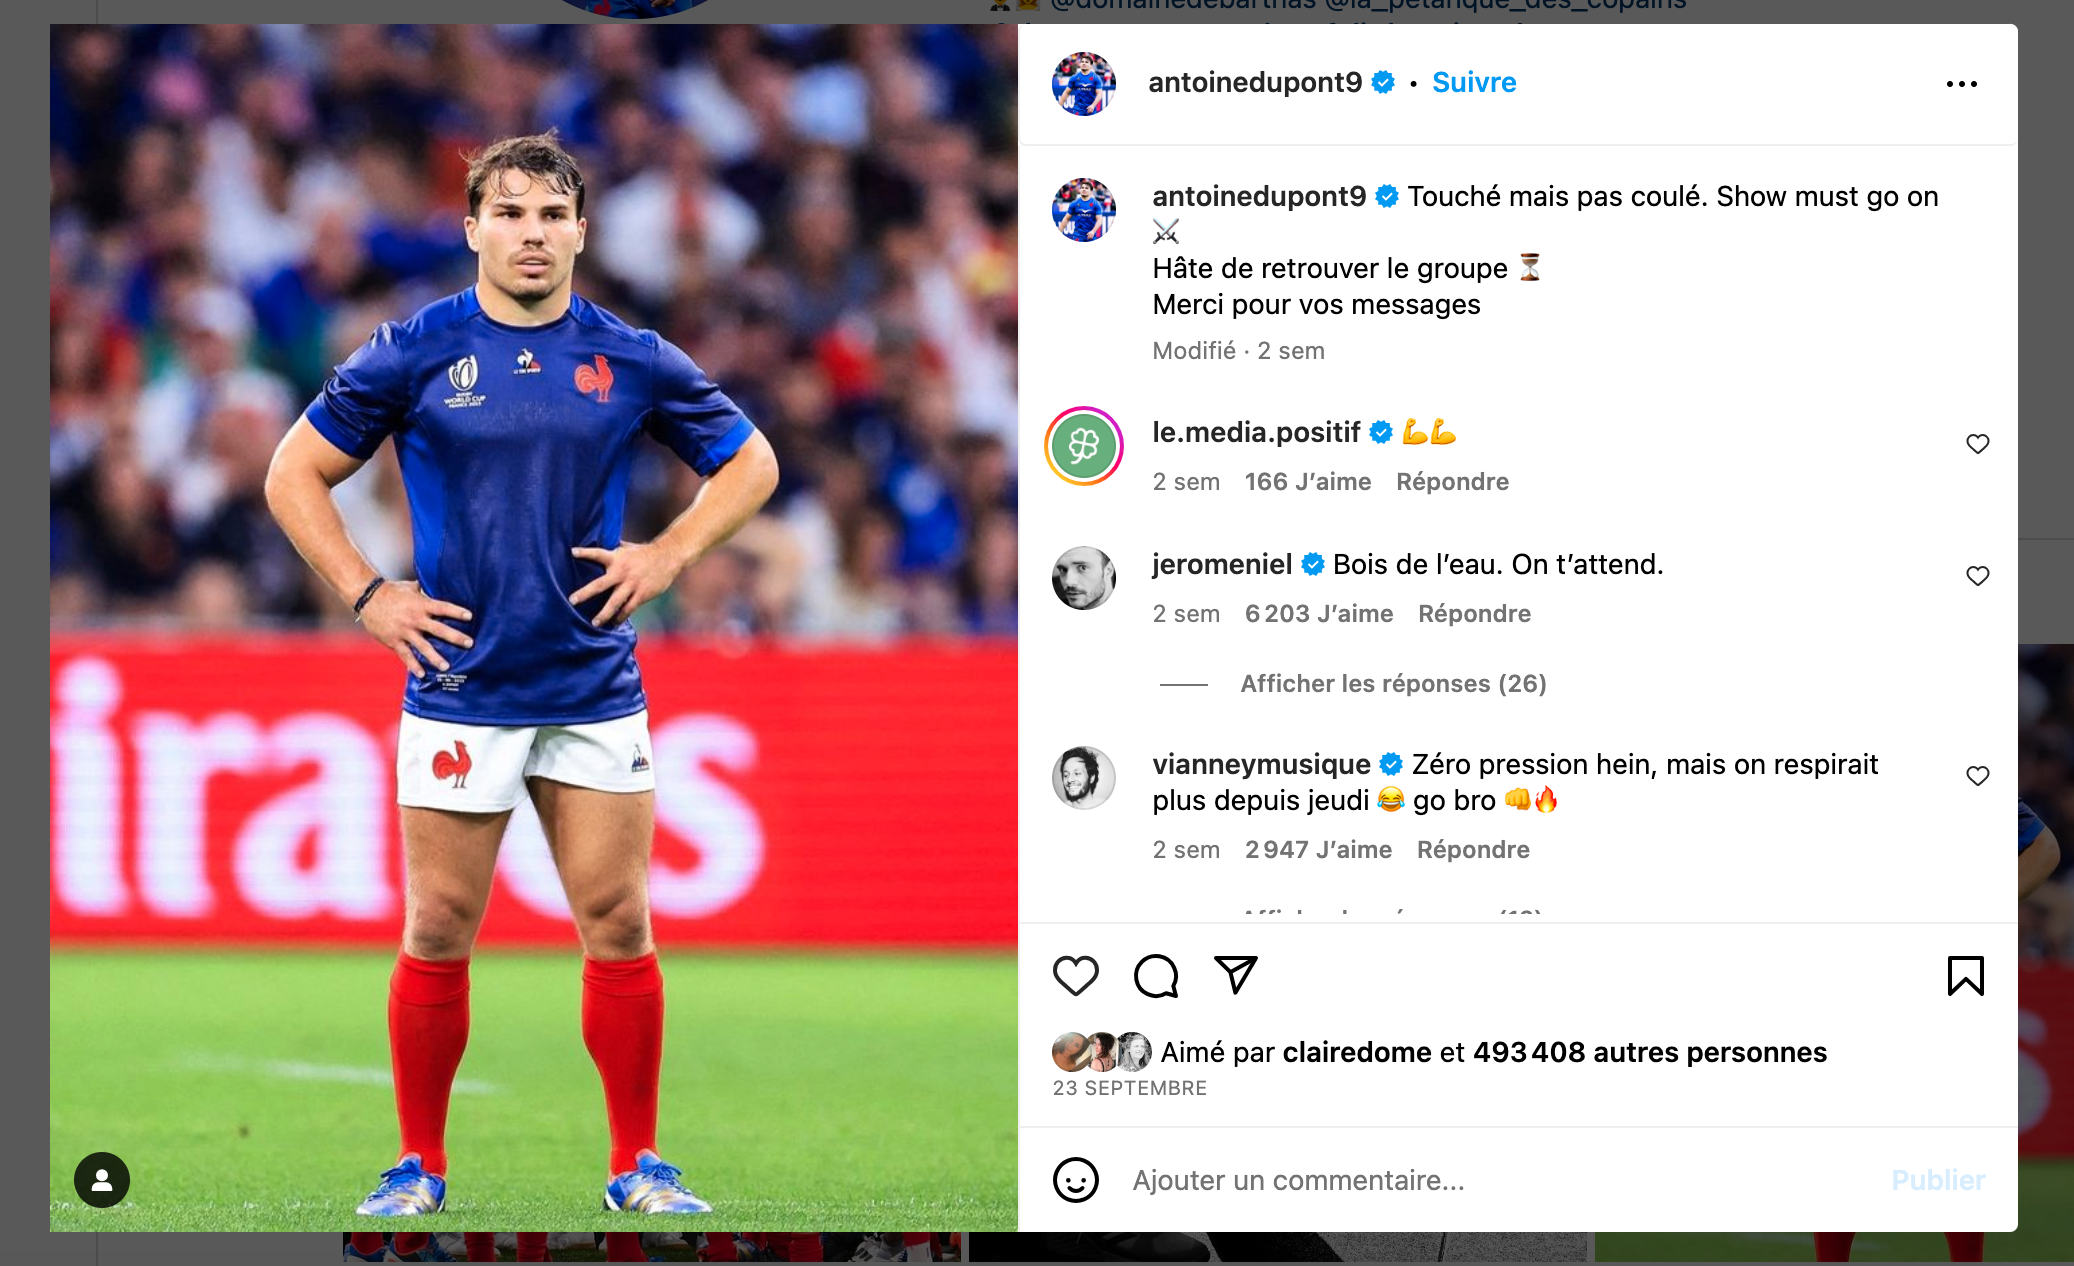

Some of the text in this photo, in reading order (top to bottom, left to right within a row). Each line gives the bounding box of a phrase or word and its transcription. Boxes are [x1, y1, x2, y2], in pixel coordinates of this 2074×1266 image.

[1149, 70, 1517, 98] antoinedupont9 Suivre
[1152, 184, 1939, 213] antoinedupont9 Touché mais pas coulé. Show must go on
[1153, 256, 1509, 285] Hâte de retrouver le groupe
[1153, 292, 1481, 321] Merci pour vos messages
[1153, 340, 1325, 361] Modifié 2 sem
[1153, 420, 1362, 448] le.media.positif
[1153, 471, 1510, 496] 2 sem 166 J’aime Répondre
[1150, 552, 1664, 580] jeromeniel Bois de l’eau. On t’attend.
[1153, 603, 1167, 623] 2
[1174, 609, 1220, 624] sem
[1317, 603, 1394, 624] J’aime
[1419, 603, 1532, 628] Répondre
[1240, 673, 1547, 698] Afficher les réponses (26)
[1152, 752, 1879, 781] vianneymusique Zéro pression hein, mais on respirait
[1153, 788, 1497, 817] plus depuis jeudi go bro
[1153, 839, 1167, 859] 2
[1174, 845, 1220, 860] sem
[1315, 839, 1393, 860] J’aime
[1417, 839, 1531, 864] Répondre
[1160, 1039, 1226, 1064] Aimé
[1233, 1046, 1276, 1068] par
[1282, 1040, 1432, 1064] clairedome
[1439, 1043, 1466, 1064] et
[1593, 1042, 1680, 1064] autres
[1687, 1046, 1828, 1068] personnes
[1053, 1079, 1207, 1097] 23 SEPTEMBRE
[1132, 1168, 1465, 1196] Ajouter un commentaire...
[1892, 1168, 1987, 1191] Publier
